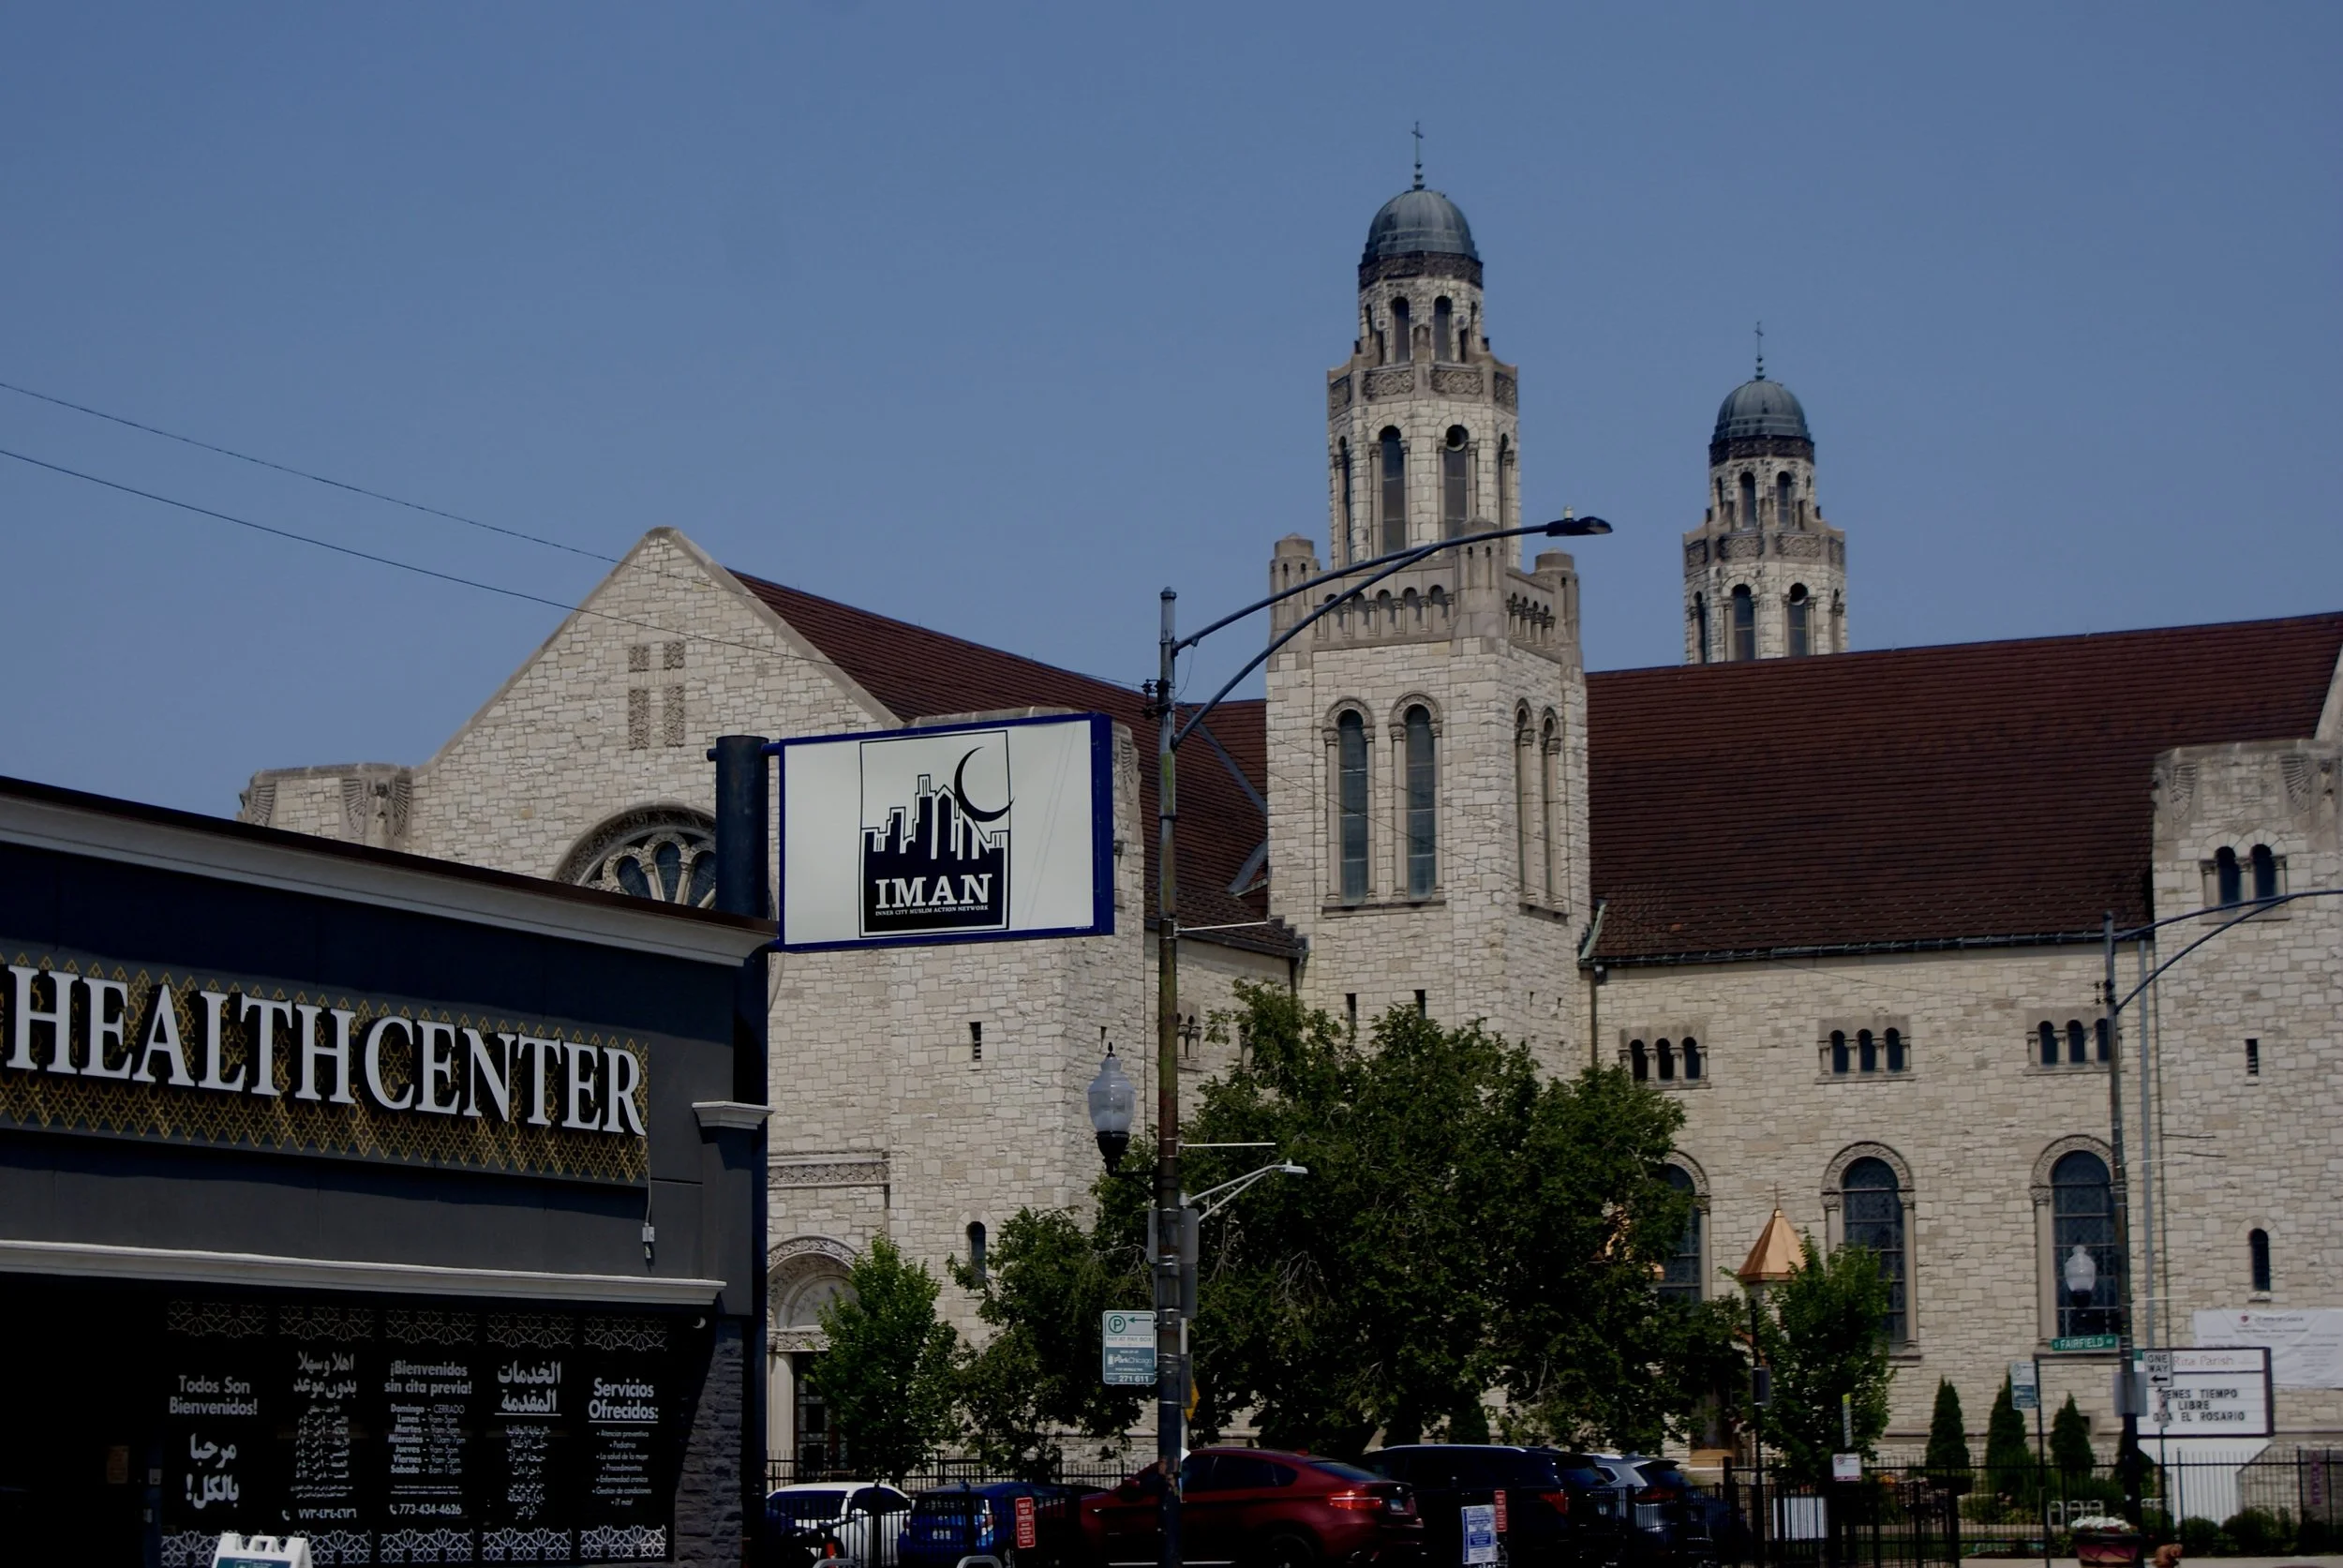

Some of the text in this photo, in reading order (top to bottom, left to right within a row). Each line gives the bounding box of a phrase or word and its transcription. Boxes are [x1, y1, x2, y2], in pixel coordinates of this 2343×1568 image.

[875, 874, 992, 909] IMAN
[6, 963, 647, 1137] HEALTH CENTER
[2059, 1337, 2105, 1350] FAIRFIELD
[2147, 1354, 2168, 1364] ONE
[2173, 1355, 2196, 1366] Rita
[2200, 1355, 2234, 1366] Parish
[390, 1359, 468, 1378] ¡Bienvenidos
[497, 1359, 562, 1385] الخدمات
[2147, 1365, 2169, 1373] WAY
[178, 1374, 251, 1395] Todos Son
[384, 1380, 472, 1396] sin cita previa!
[593, 1377, 655, 1398] Servicios
[500, 1387, 558, 1413] المقدمة
[2199, 1389, 2239, 1399] TIEMPO
[169, 1396, 259, 1416] Bienvenidos!
[390, 1403, 466, 1415] Domingo CERRADO
[588, 1398, 660, 1420] Ofrecidos:
[2177, 1400, 2211, 1411] LIBRE
[396, 1414, 420, 1424] Lunes
[2180, 1411, 2192, 1422] EL
[2199, 1411, 2246, 1422] ROSARIO
[395, 1424, 423, 1433] Martes
[188, 1432, 238, 1470] مرحبا
[395, 1444, 421, 1454] Jueves
[393, 1454, 423, 1464] Viernes
[185, 1472, 240, 1510] بالكل!
[398, 1503, 463, 1516] 773-434-4626
